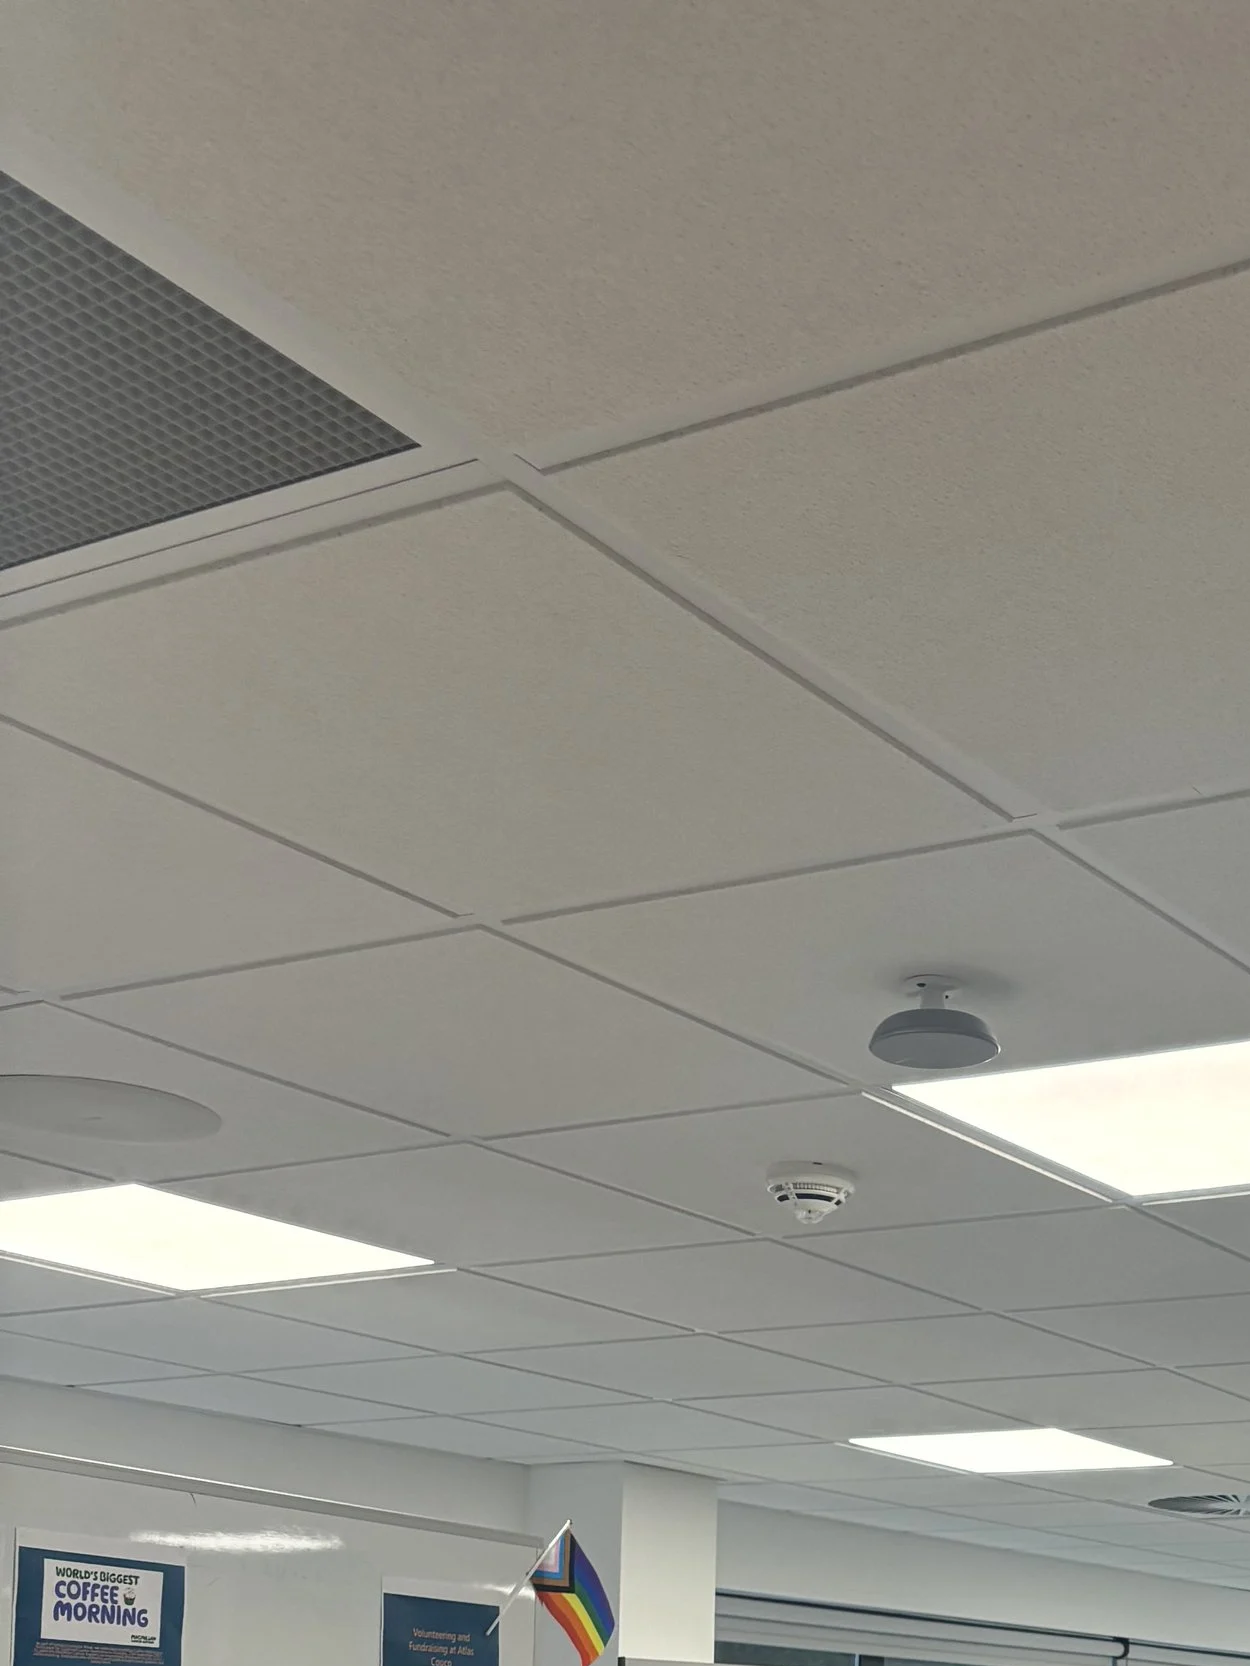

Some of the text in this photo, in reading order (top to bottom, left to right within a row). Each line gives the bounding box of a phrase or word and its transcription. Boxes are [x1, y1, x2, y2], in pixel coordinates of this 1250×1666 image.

[55, 1566, 139, 1585] WORLD'S BIGGEST
[55, 1580, 119, 1605] COFFEE
[53, 1600, 148, 1627] MORNING
[413, 1628, 471, 1643] Volunteering and
[457, 1646, 475, 1656] Atlas
